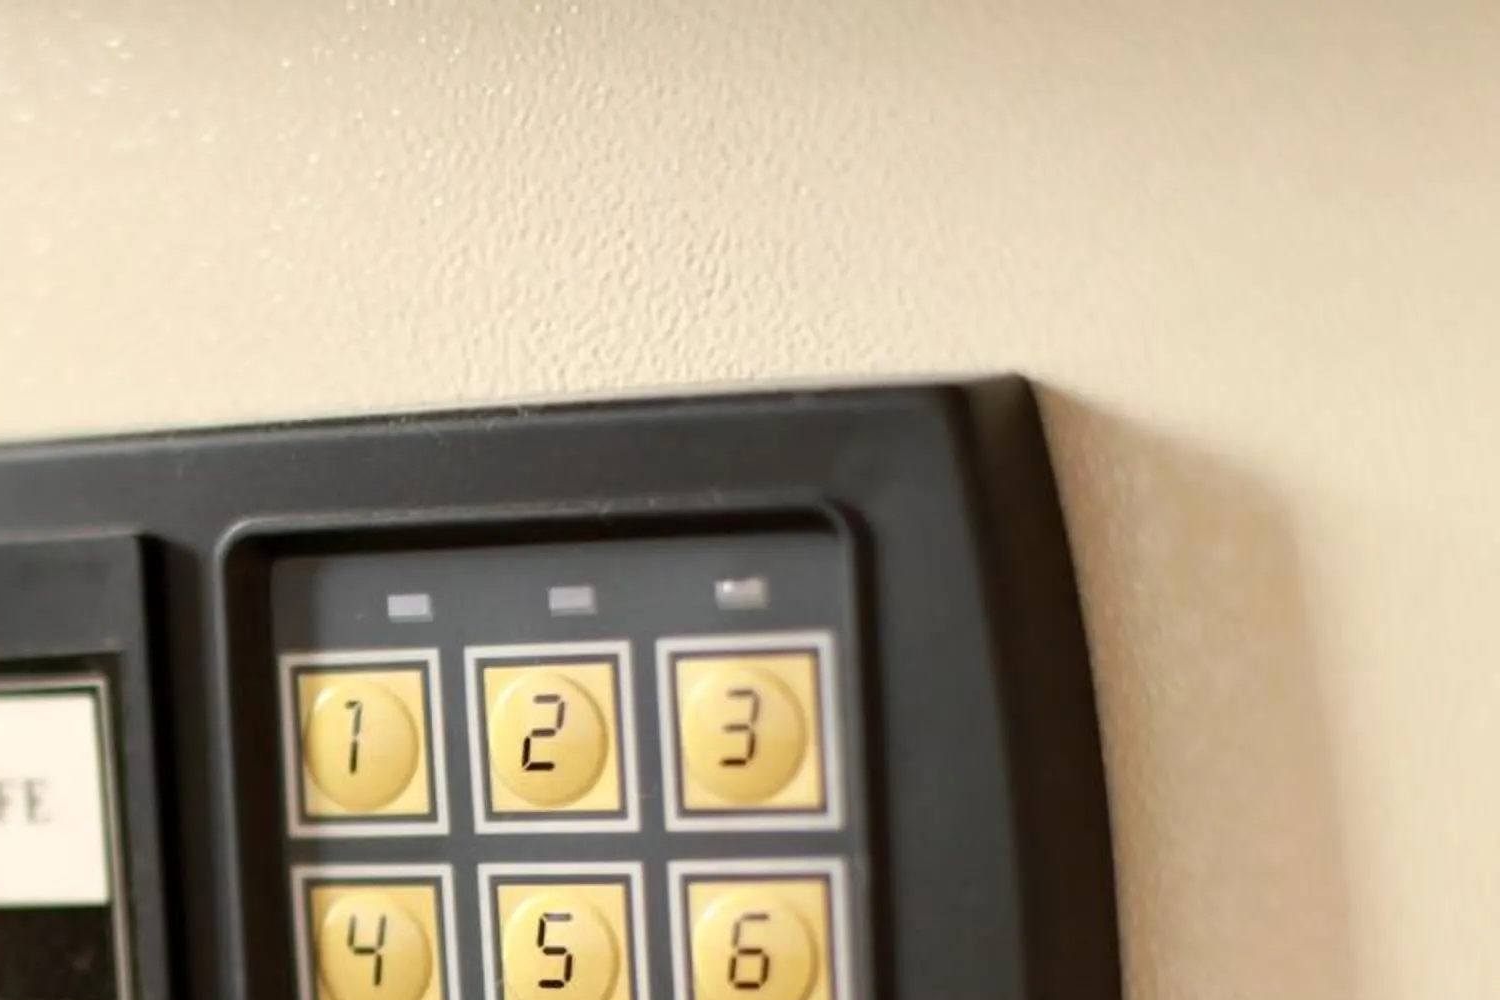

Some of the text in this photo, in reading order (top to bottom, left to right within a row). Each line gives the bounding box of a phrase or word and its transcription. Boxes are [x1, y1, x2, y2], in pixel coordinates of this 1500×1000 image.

[343, 700, 363, 775] 1
[521, 694, 565, 772] 2
[719, 688, 761, 768] 3
[346, 912, 388, 988] 4
[536, 912, 574, 989] 5
[727, 912, 771, 991] 6
